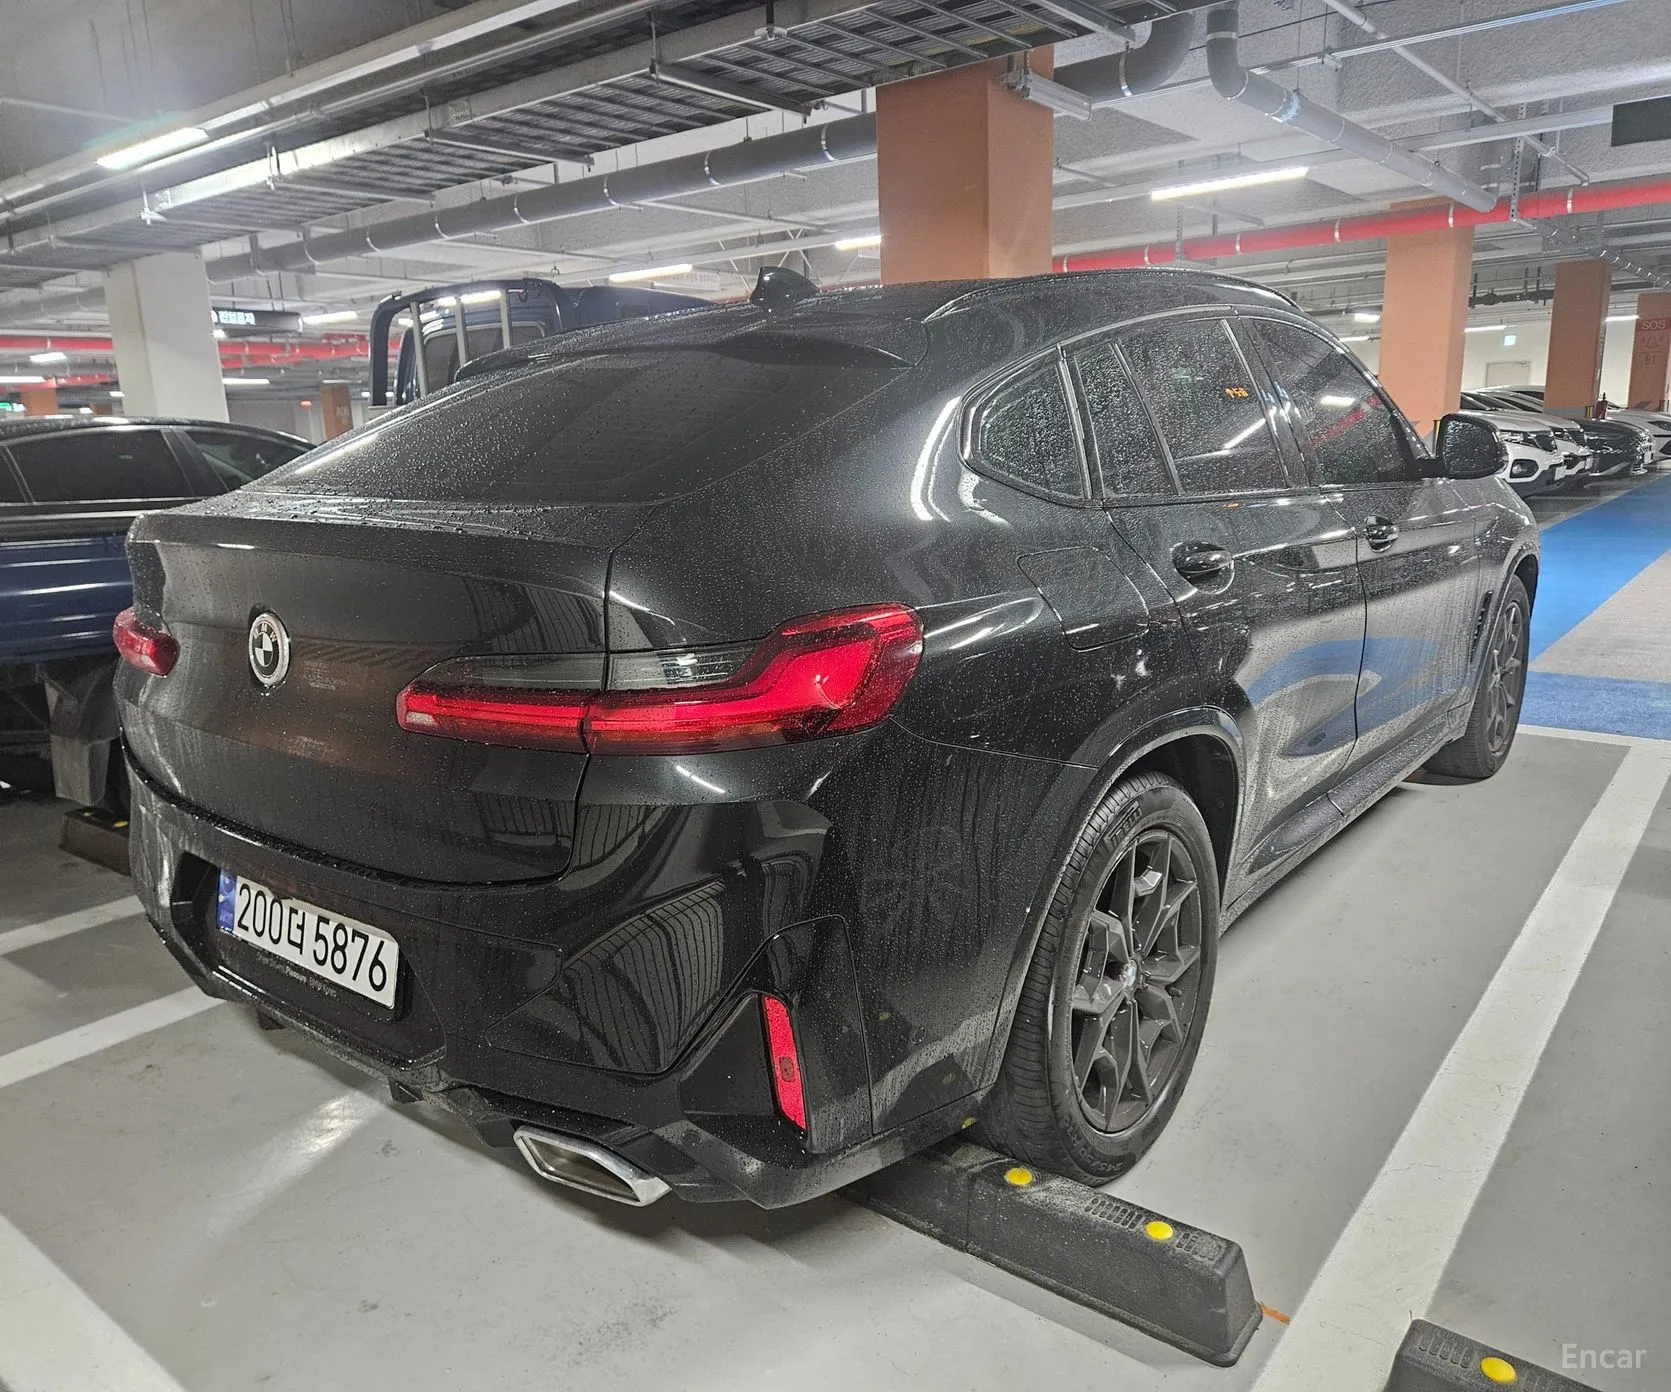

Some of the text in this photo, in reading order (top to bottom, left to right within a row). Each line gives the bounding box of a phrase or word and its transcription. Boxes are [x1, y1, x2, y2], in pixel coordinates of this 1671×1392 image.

[1641, 319, 1666, 330] SOS
[253, 622, 277, 642] BMW
[237, 883, 387, 992] 200터 5876
